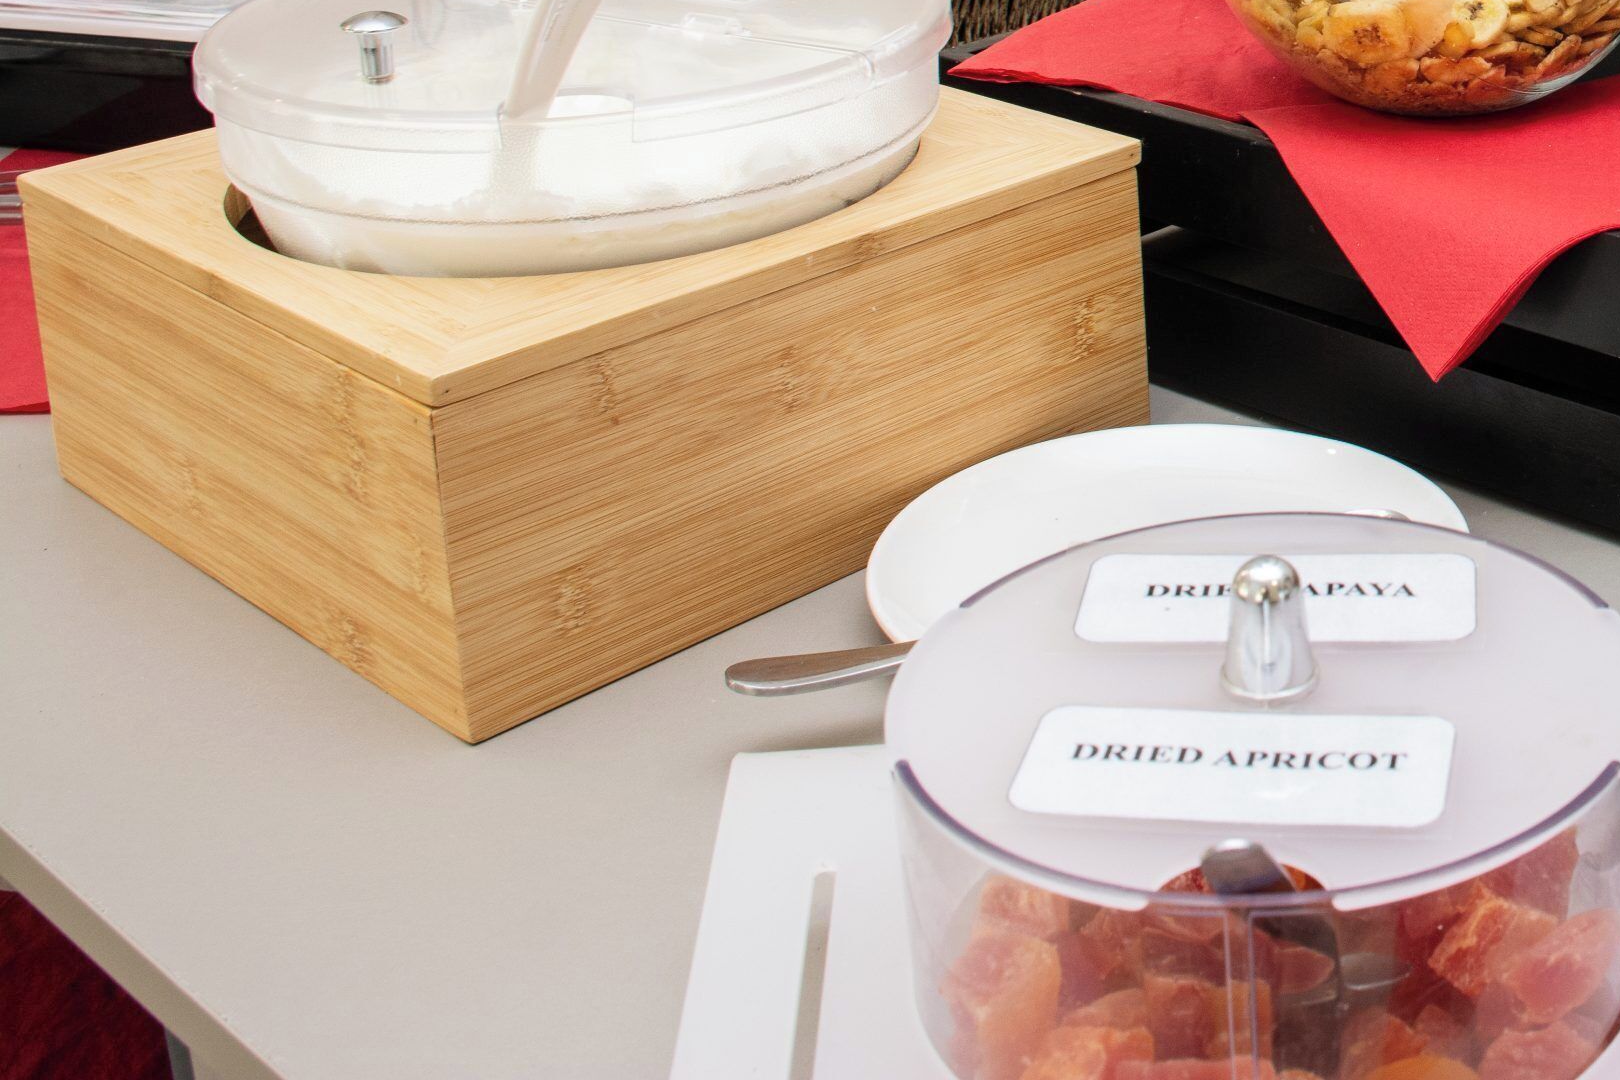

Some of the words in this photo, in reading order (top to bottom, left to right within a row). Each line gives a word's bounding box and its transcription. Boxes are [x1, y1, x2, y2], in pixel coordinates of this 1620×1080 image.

[1145, 583, 1235, 598] DRIE
[1304, 582, 1416, 598] APAYA
[1071, 743, 1203, 765] DRIED
[1213, 750, 1409, 771] APRICOT
